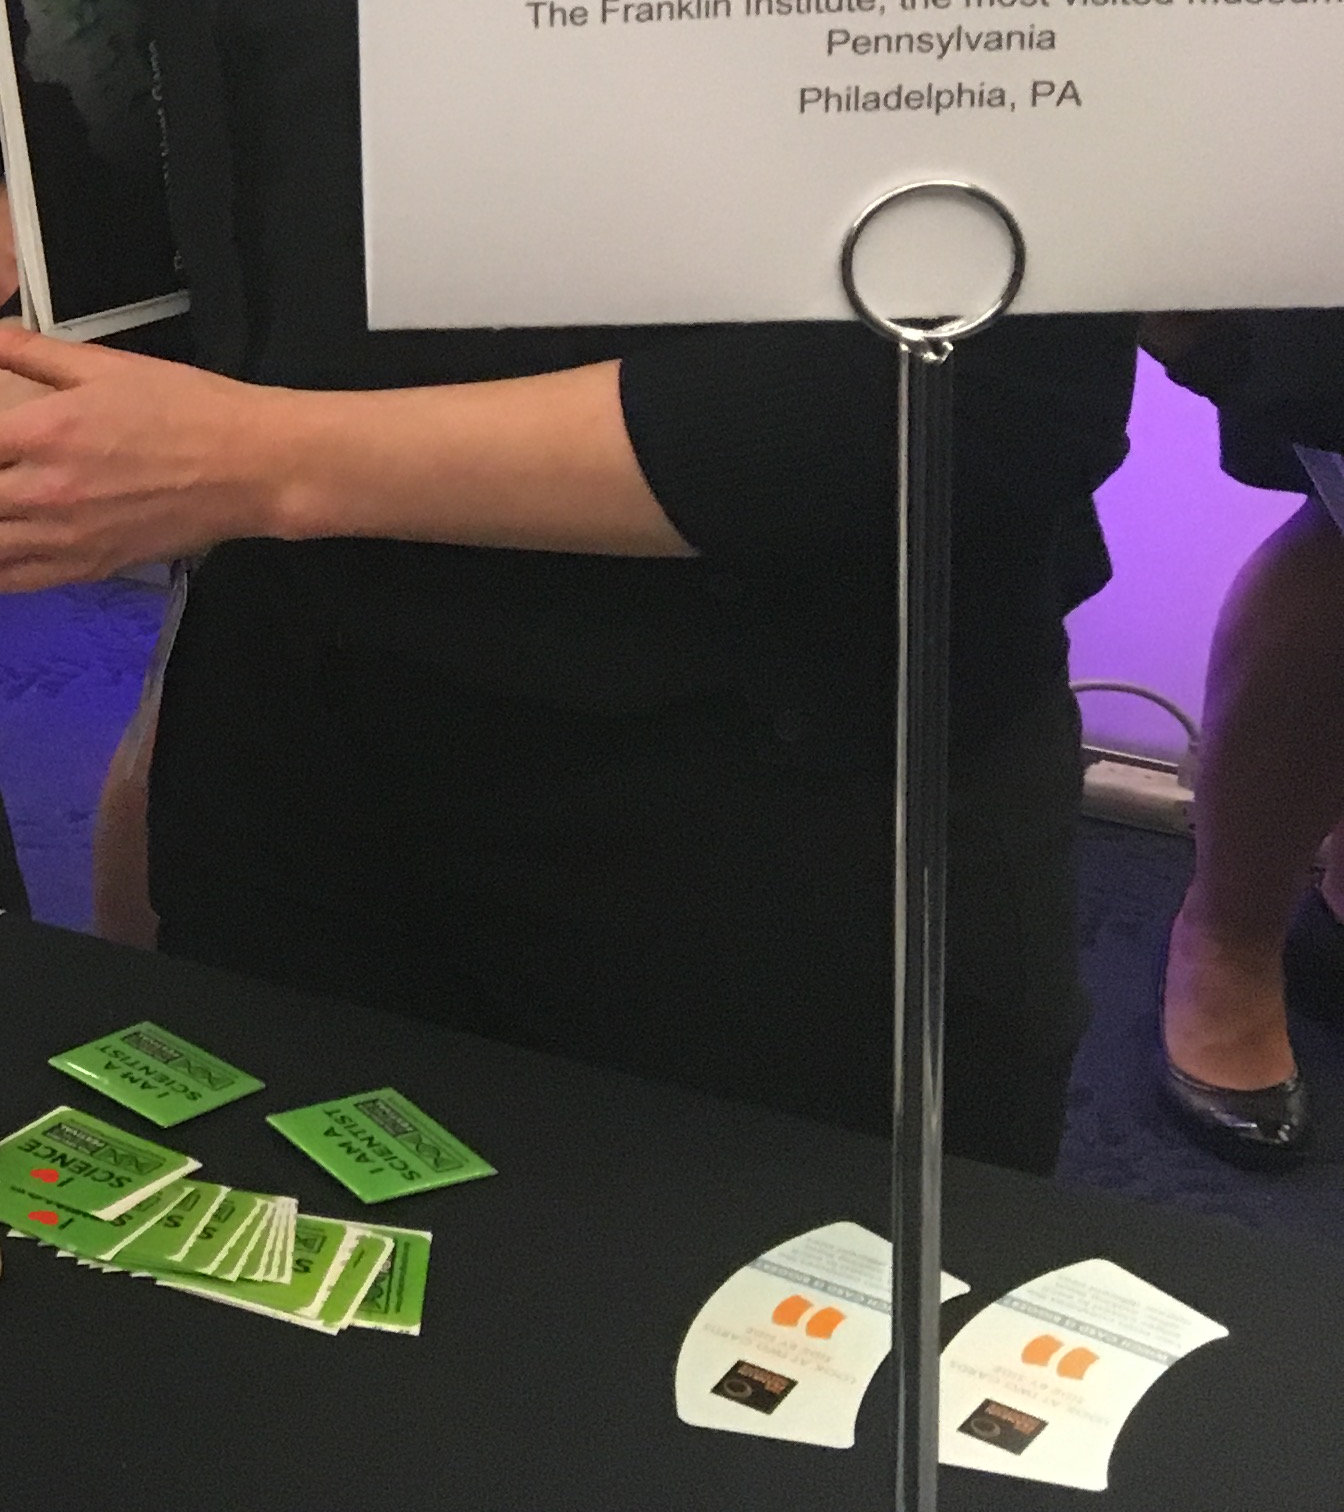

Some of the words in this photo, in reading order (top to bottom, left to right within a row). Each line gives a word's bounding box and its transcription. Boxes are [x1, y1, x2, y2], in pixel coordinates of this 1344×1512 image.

[525, 0, 589, 30] The
[826, 23, 1056, 61] Pennsylvania
[799, 80, 1016, 117] Philadelphia,
[1030, 79, 1083, 108] PA
[95, 1044, 203, 1102] SCIENTIST
[17, 1138, 133, 1189] SCIENCE
[322, 1108, 422, 1181] SCIENTIST
